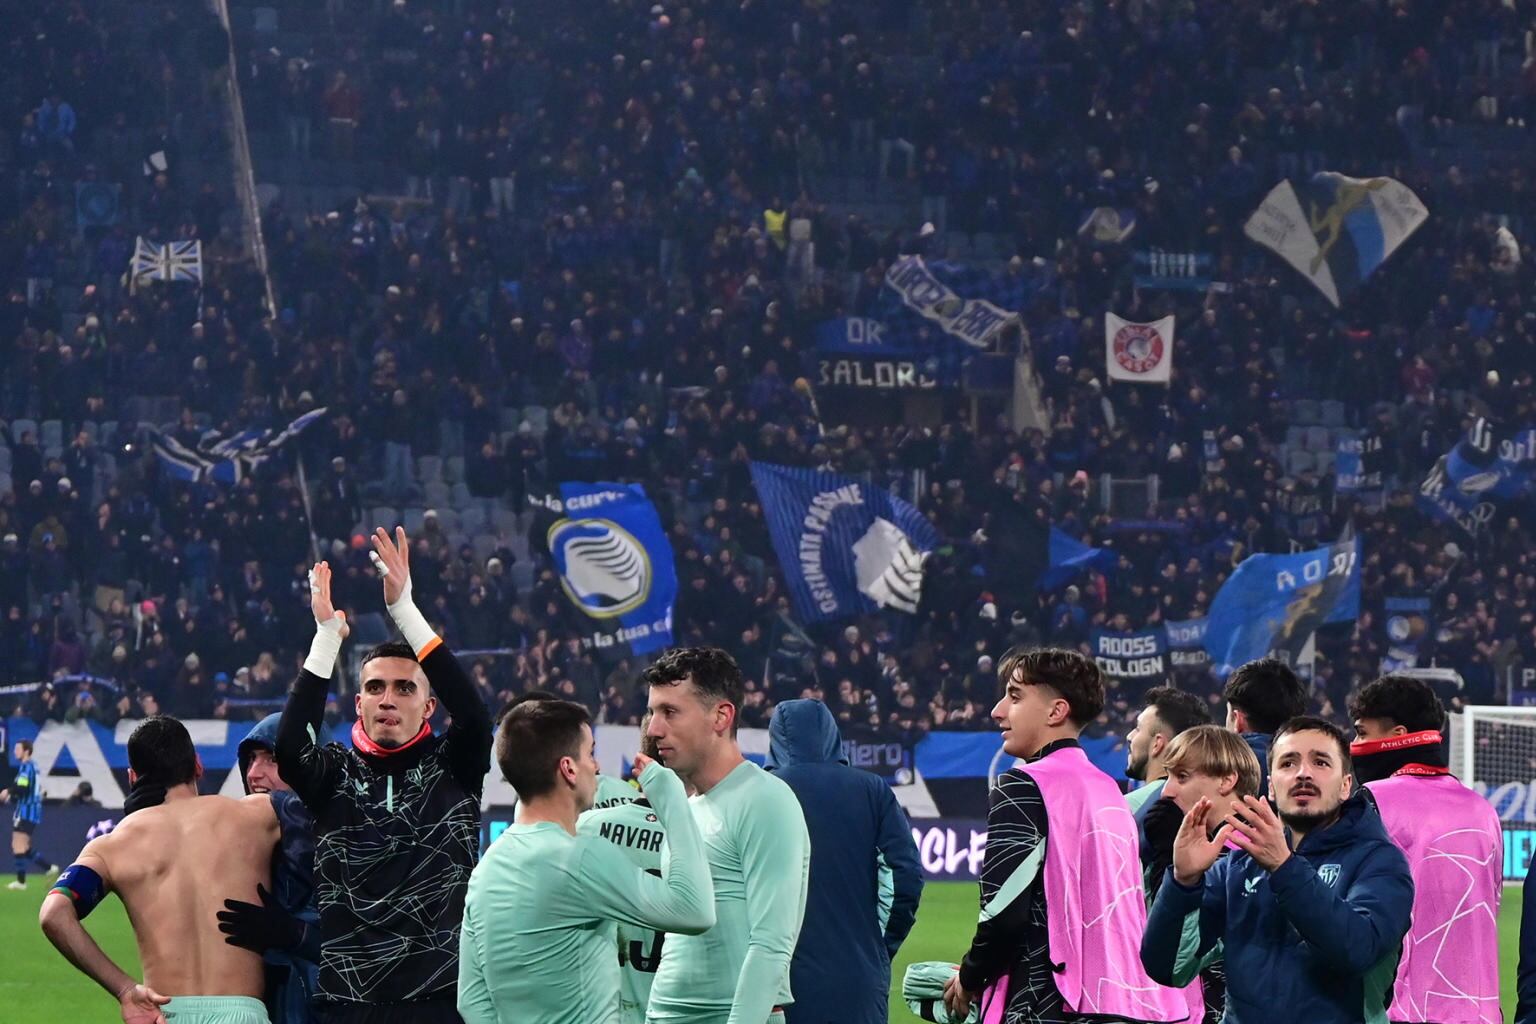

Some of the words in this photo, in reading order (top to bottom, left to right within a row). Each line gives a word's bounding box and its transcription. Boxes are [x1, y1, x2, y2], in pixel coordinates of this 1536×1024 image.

[565, 490, 627, 510] curv
[1098, 635, 1158, 657] ADOSS
[1380, 735, 1420, 749] ATHLETIC
[599, 822, 665, 853] NAVAR
